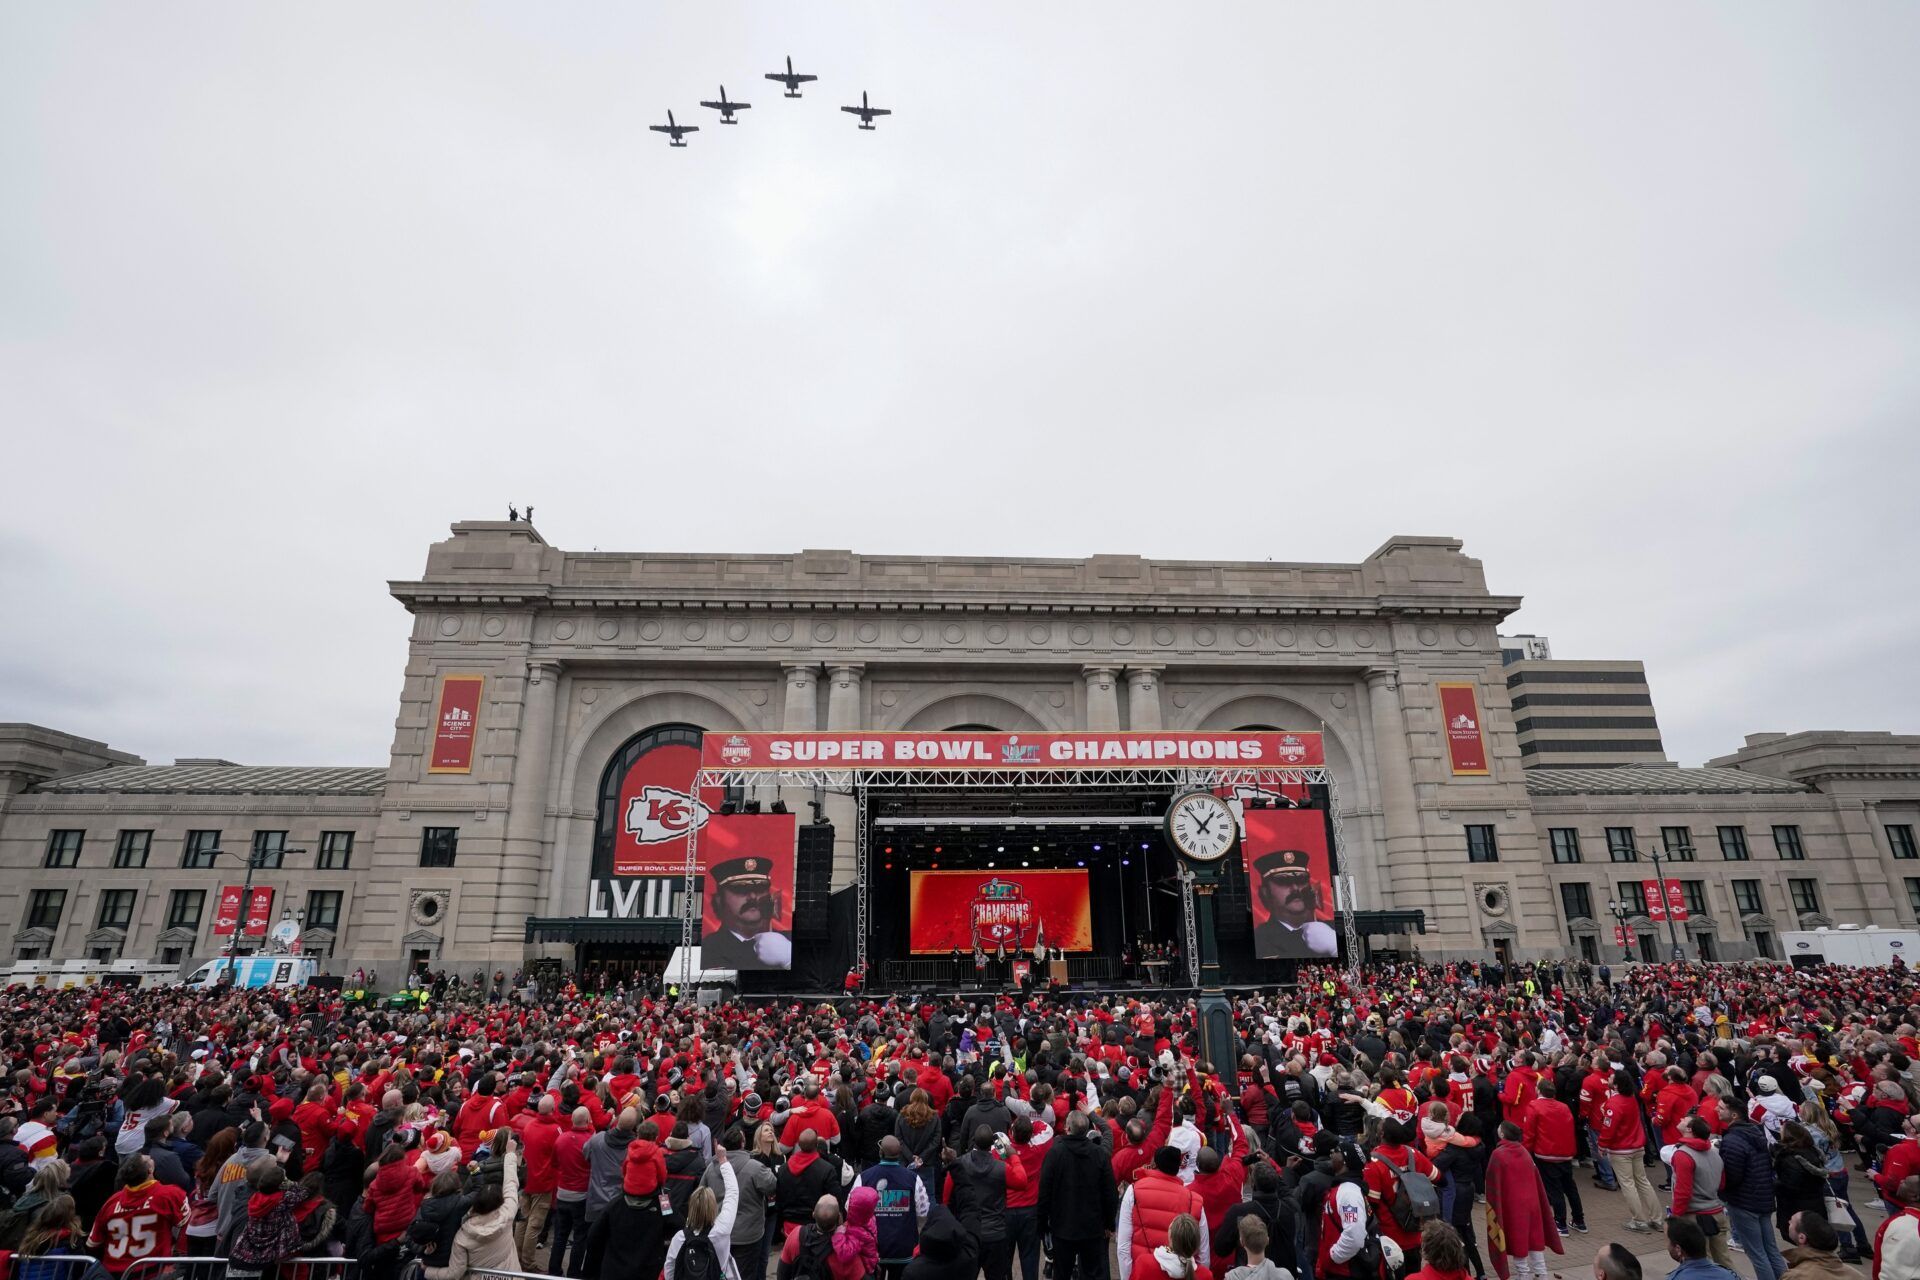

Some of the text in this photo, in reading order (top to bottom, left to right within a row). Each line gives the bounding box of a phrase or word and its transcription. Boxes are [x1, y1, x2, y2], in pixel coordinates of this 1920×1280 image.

[769, 740, 1263, 760] SUPER BOWL CHAMPIONS
[647, 799, 695, 831] KC
[588, 879, 671, 918] LVII
[974, 903, 1030, 924] CHAMPIONS
[1292, 1040, 1304, 1053] 10
[1462, 1092, 1474, 1111] 15
[1344, 1212, 1358, 1223] NFL
[106, 1214, 158, 1259] 35
